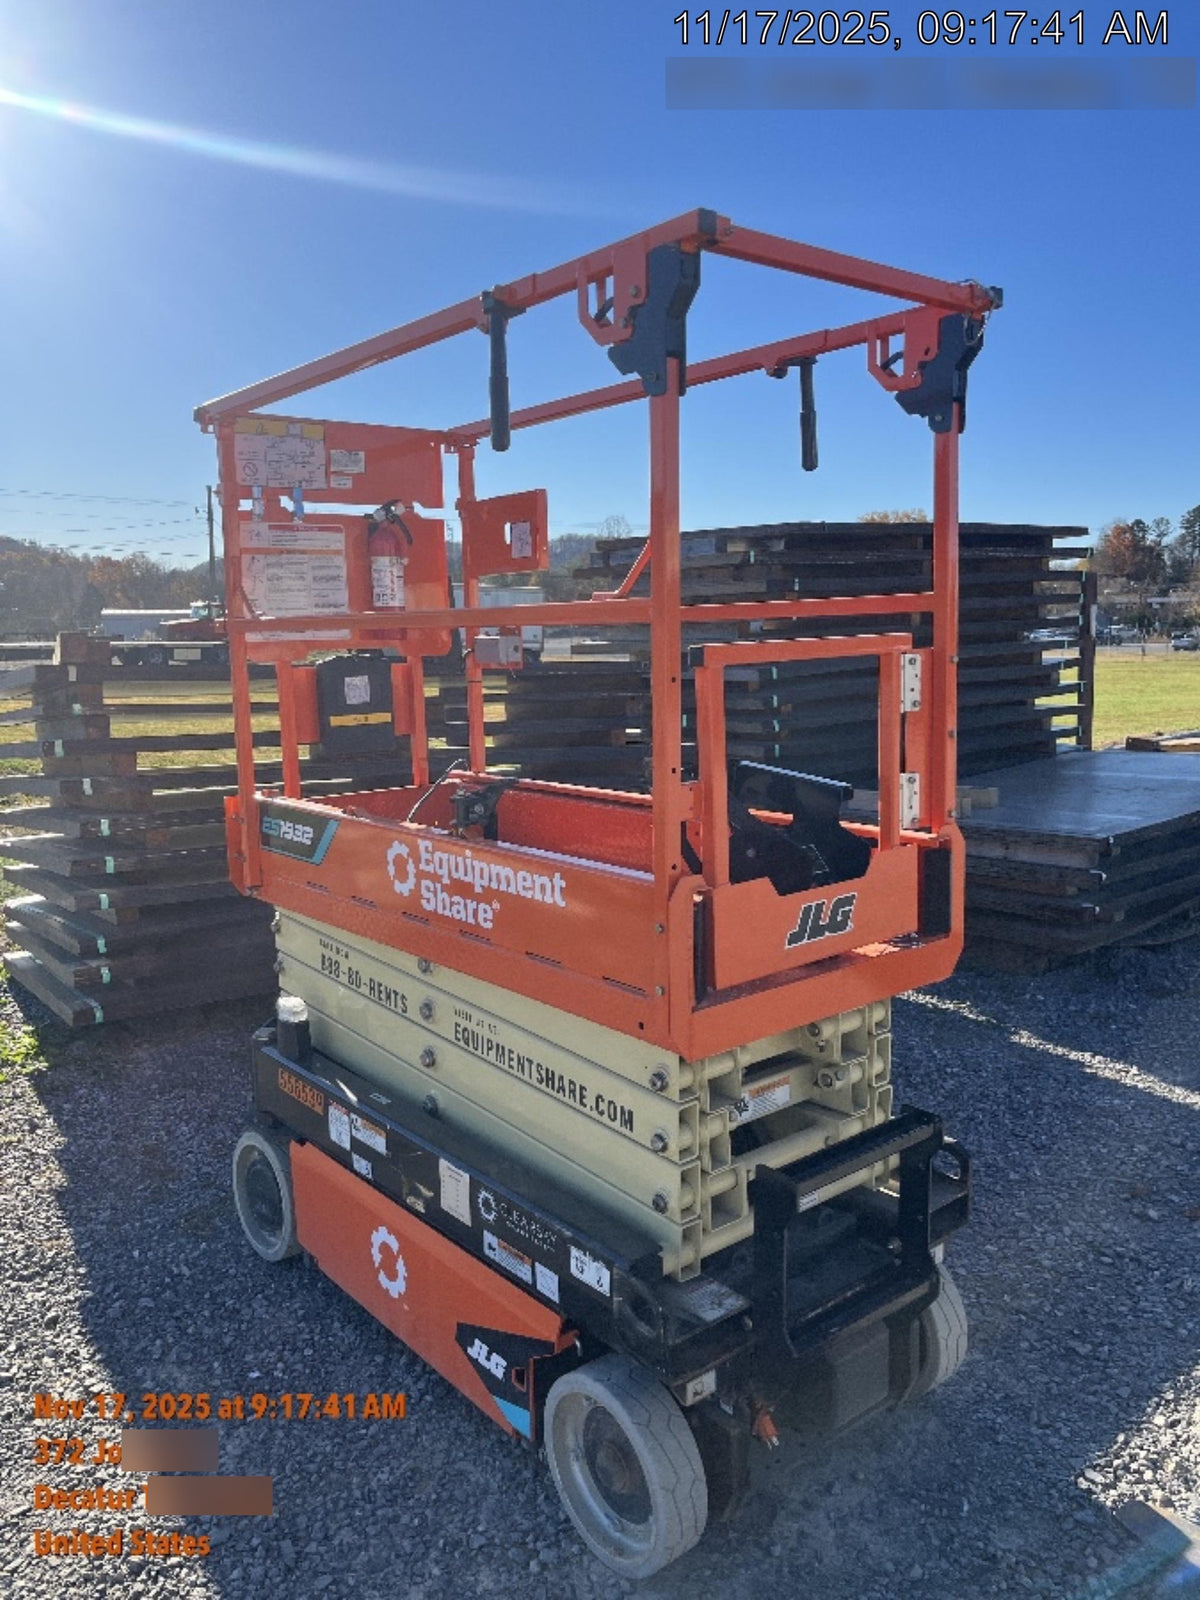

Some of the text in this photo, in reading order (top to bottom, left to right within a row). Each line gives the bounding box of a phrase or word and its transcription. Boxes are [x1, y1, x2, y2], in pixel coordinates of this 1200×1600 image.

[418, 839, 566, 907] Equipment
[420, 879, 494, 929] Share
[785, 892, 857, 949] JLG
[454, 1022, 635, 1133] EQUIPMENTSHARE.COM
[467, 1338, 507, 1381] JLG
